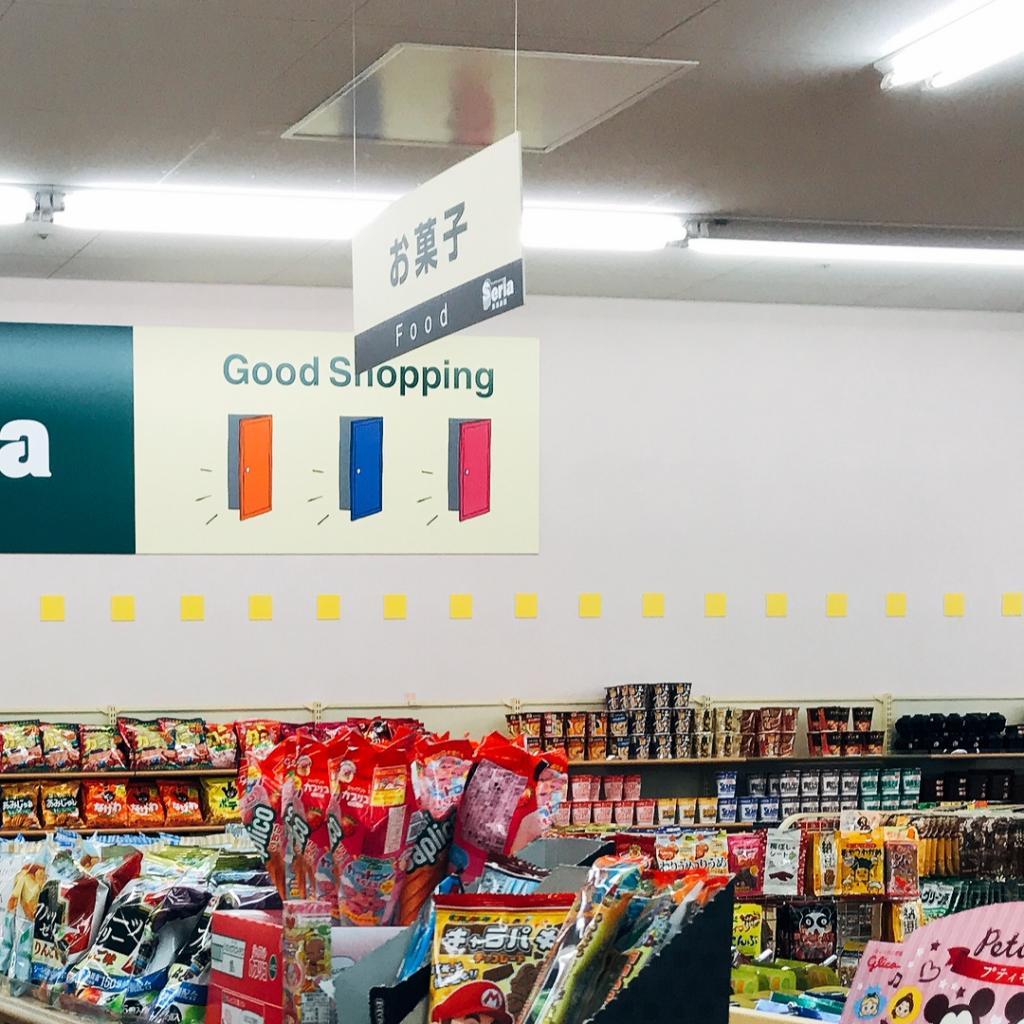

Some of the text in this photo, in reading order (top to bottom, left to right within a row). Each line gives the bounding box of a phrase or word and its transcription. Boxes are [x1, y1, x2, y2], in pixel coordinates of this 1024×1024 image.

[389, 201, 468, 287] お菓子
[395, 303, 449, 347] Food
[222, 353, 320, 387] Good
[442, 925, 559, 953] キャラパキ
[973, 928, 1024, 959] Pet
